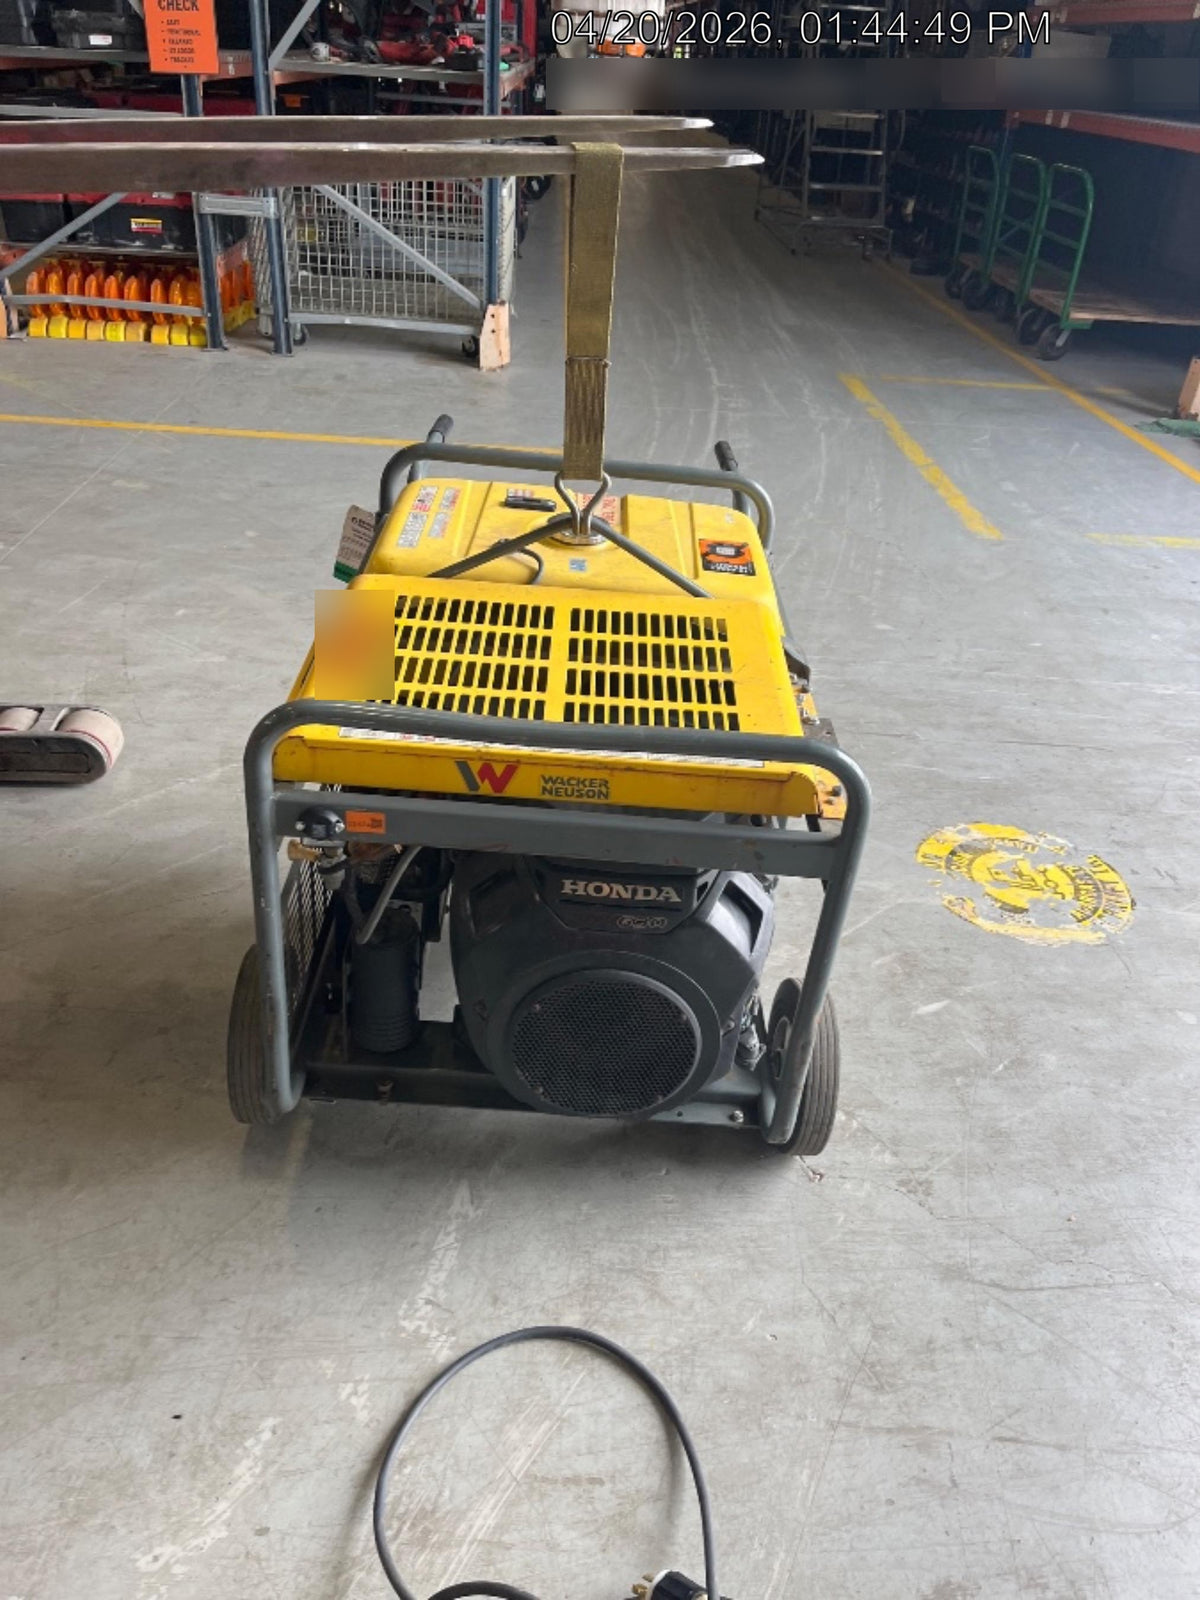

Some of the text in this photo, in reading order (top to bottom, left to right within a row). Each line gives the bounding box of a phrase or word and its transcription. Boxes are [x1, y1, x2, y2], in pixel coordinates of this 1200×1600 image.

[157, 0, 200, 11] CHECK
[540, 774, 610, 790] WACKER
[541, 786, 609, 801] NEUSON
[561, 879, 682, 902] HONDA
